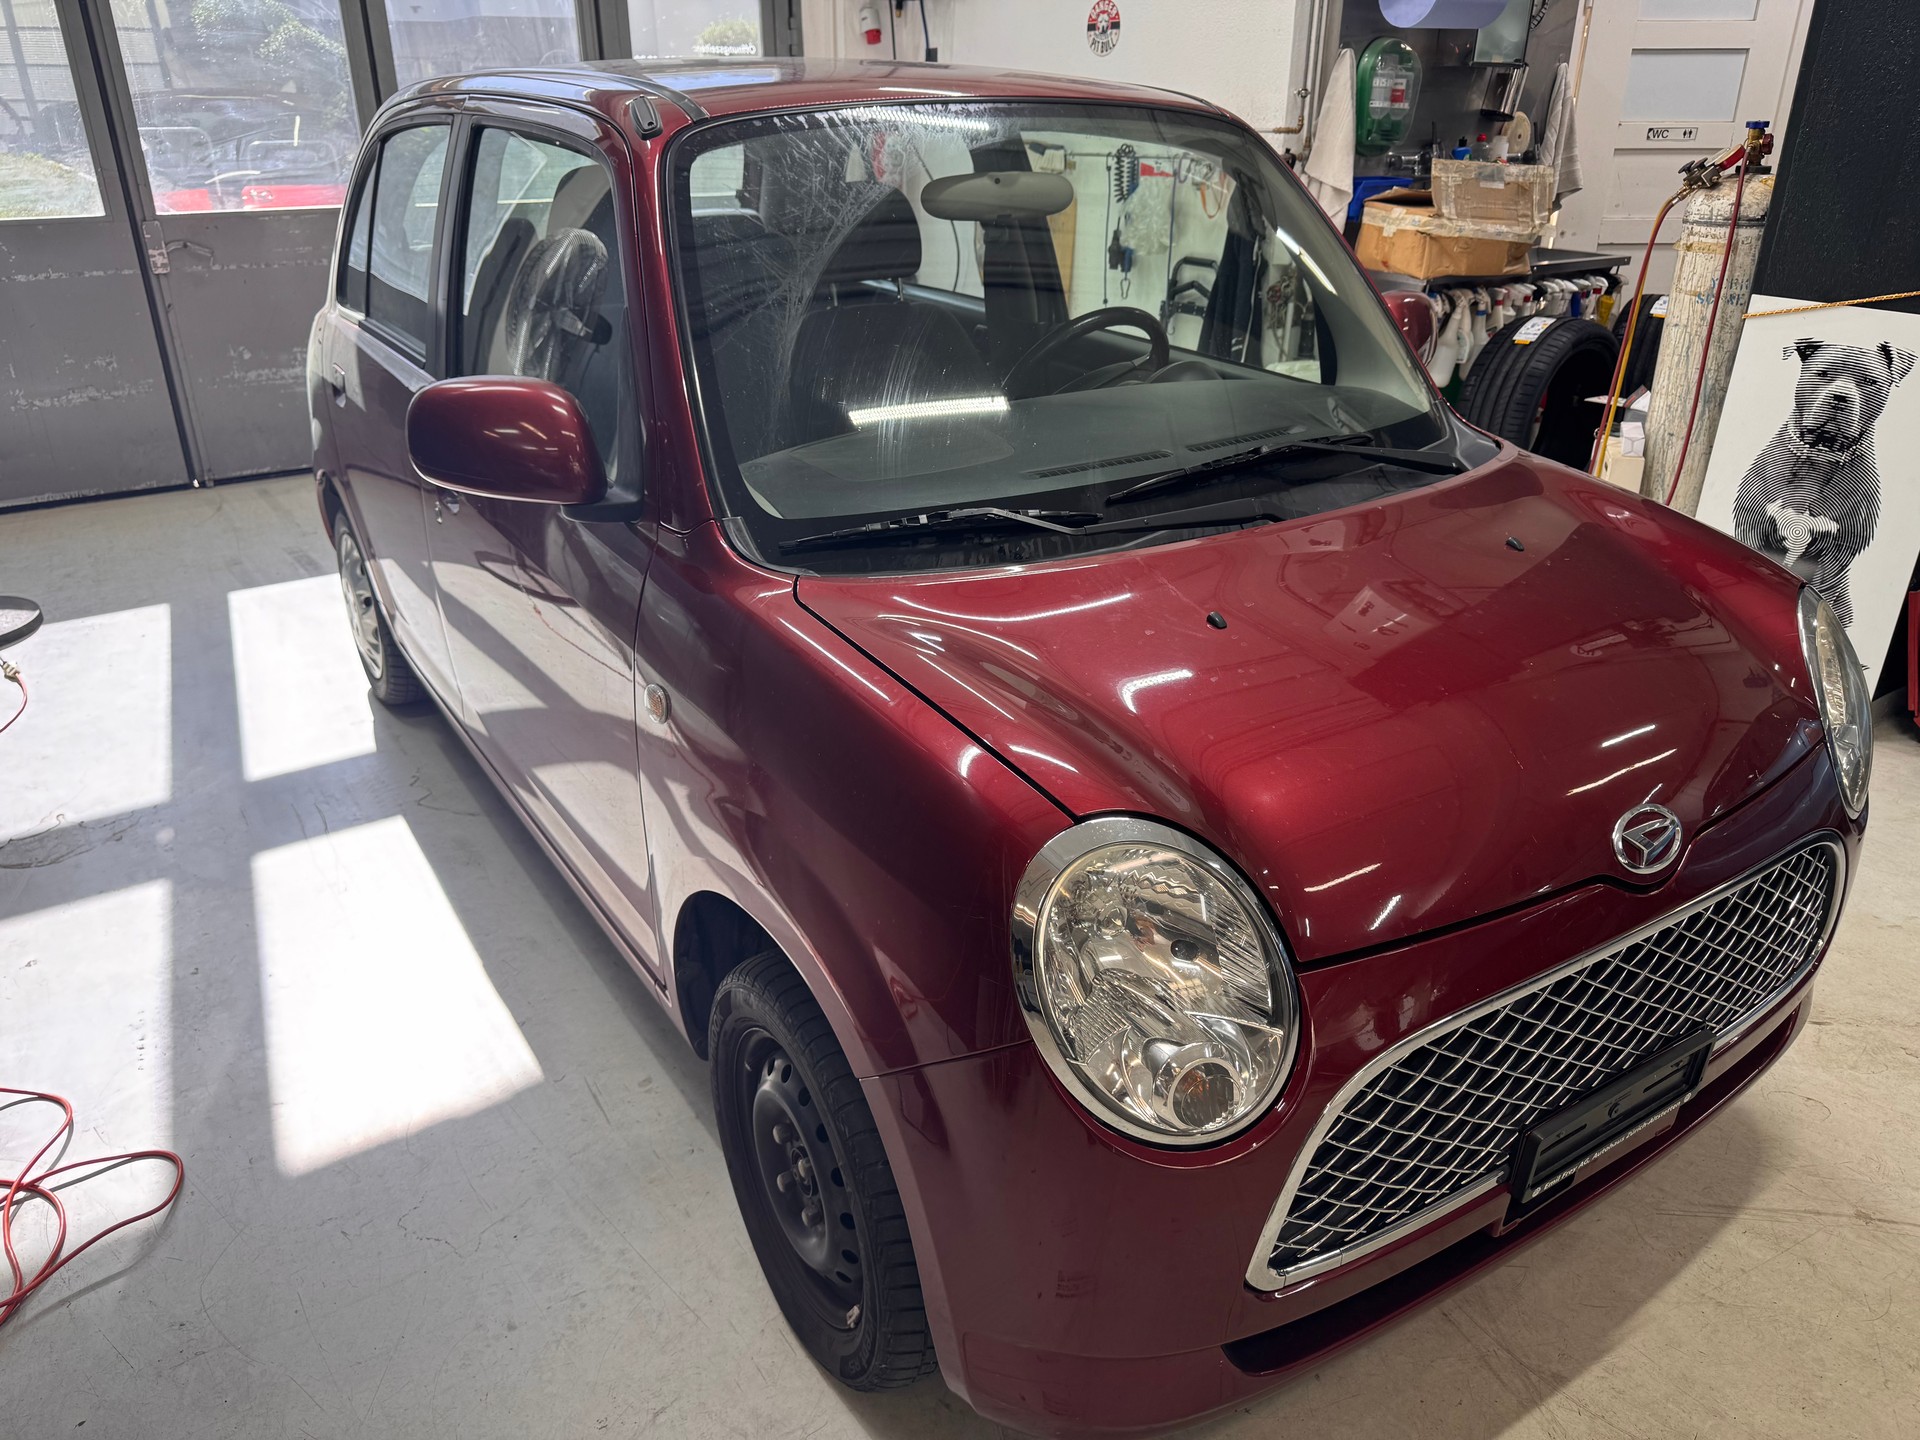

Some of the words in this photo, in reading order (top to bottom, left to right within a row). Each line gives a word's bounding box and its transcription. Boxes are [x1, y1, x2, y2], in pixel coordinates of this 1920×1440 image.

[1090, 37, 1100, 52] PIT
[1100, 37, 1115, 53] BULL
[1652, 129, 1670, 139] WC
[1561, 1166, 1578, 1180] Frey
[1591, 1136, 1625, 1160] Autohaus
